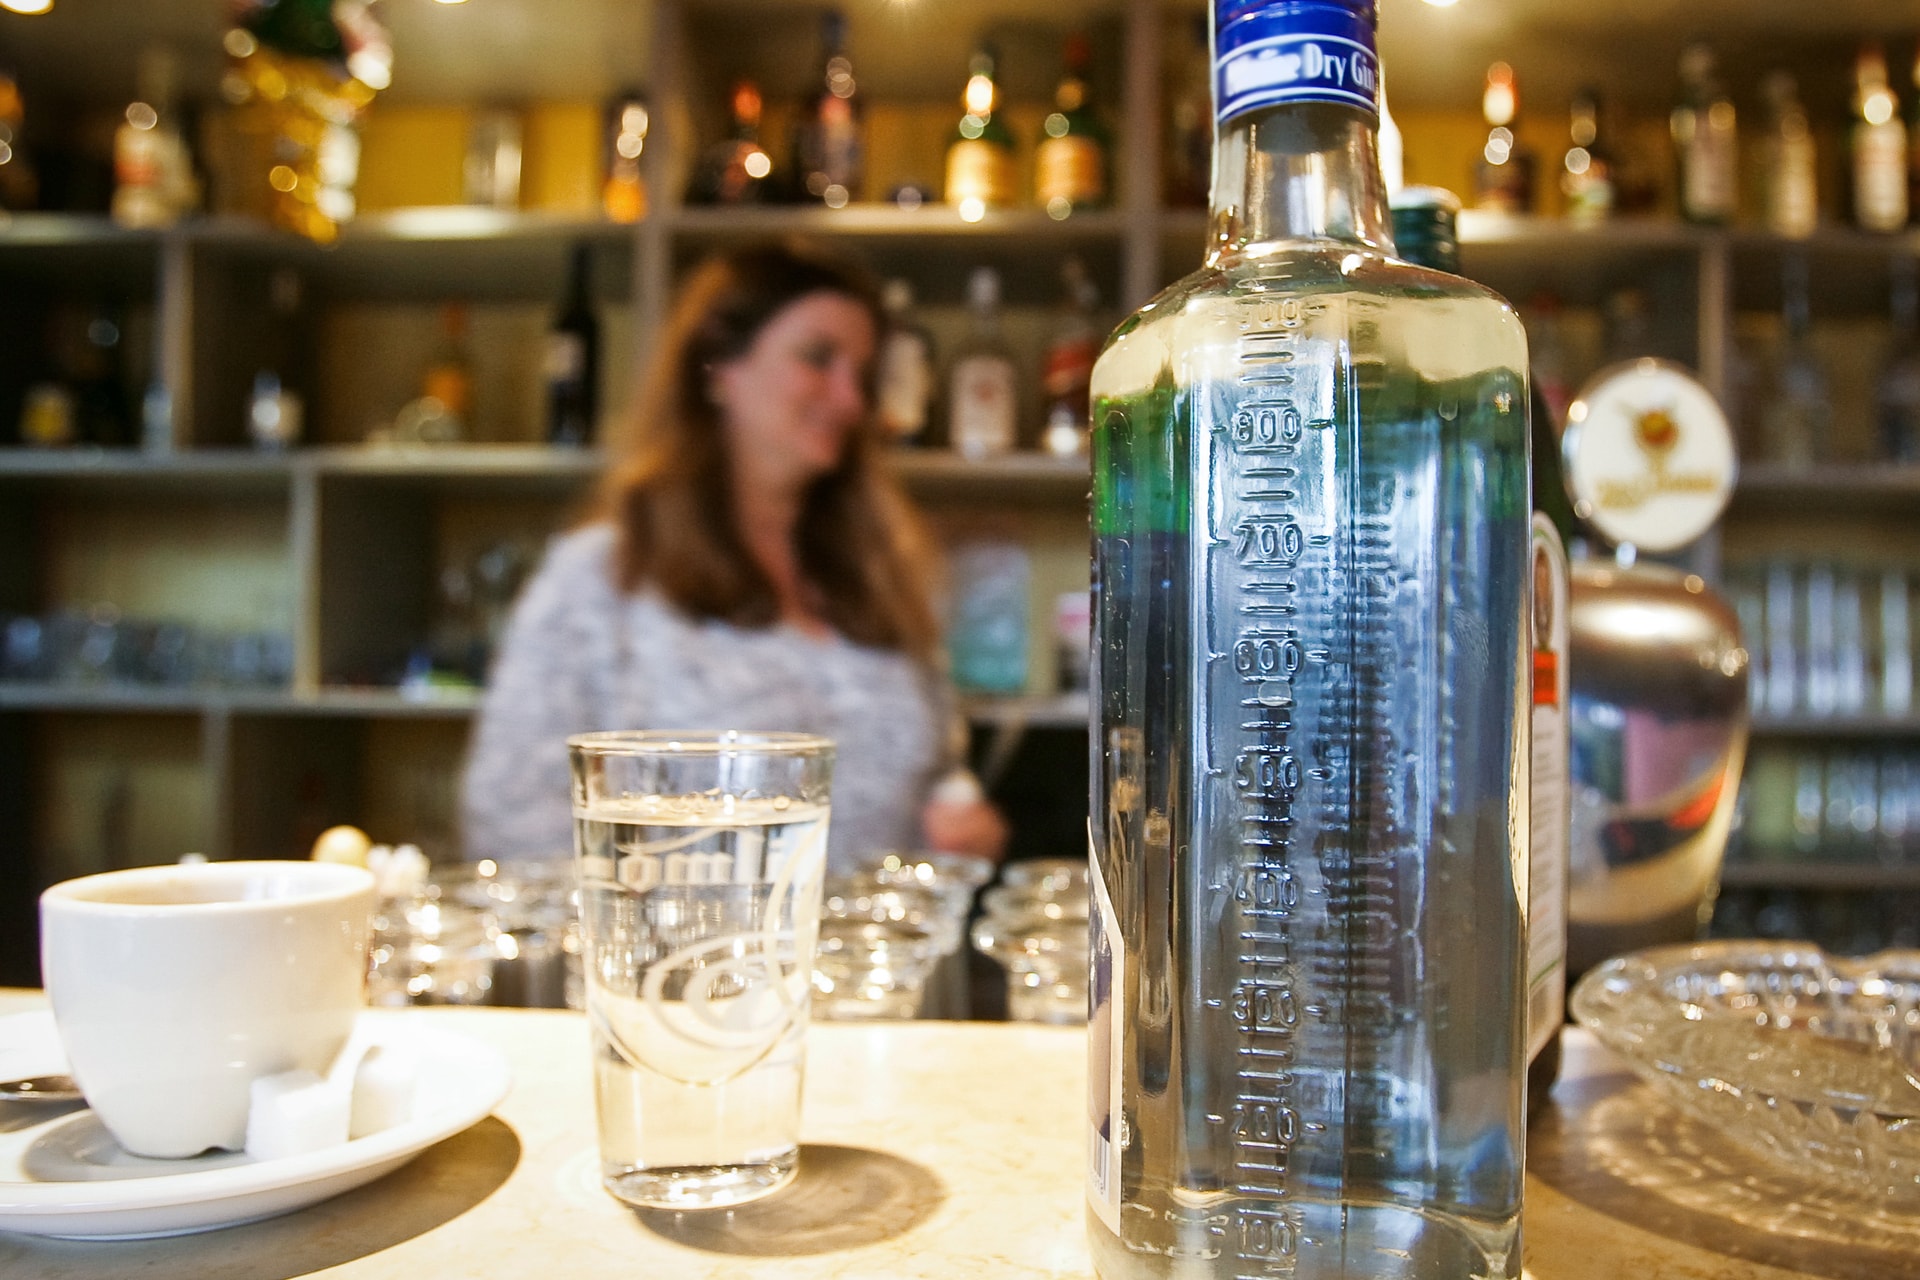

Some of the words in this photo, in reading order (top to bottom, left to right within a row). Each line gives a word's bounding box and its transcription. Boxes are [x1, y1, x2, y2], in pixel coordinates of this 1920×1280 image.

[1302, 42, 1347, 87] Dry
[1351, 51, 1375, 93] Gin
[1232, 408, 1301, 443] 800
[1232, 524, 1303, 558] 700
[1234, 639, 1302, 677] 600
[1233, 754, 1301, 792] 500
[1232, 987, 1299, 1027] 300
[1231, 1103, 1298, 1143] 200
[1236, 1217, 1296, 1256] 100
